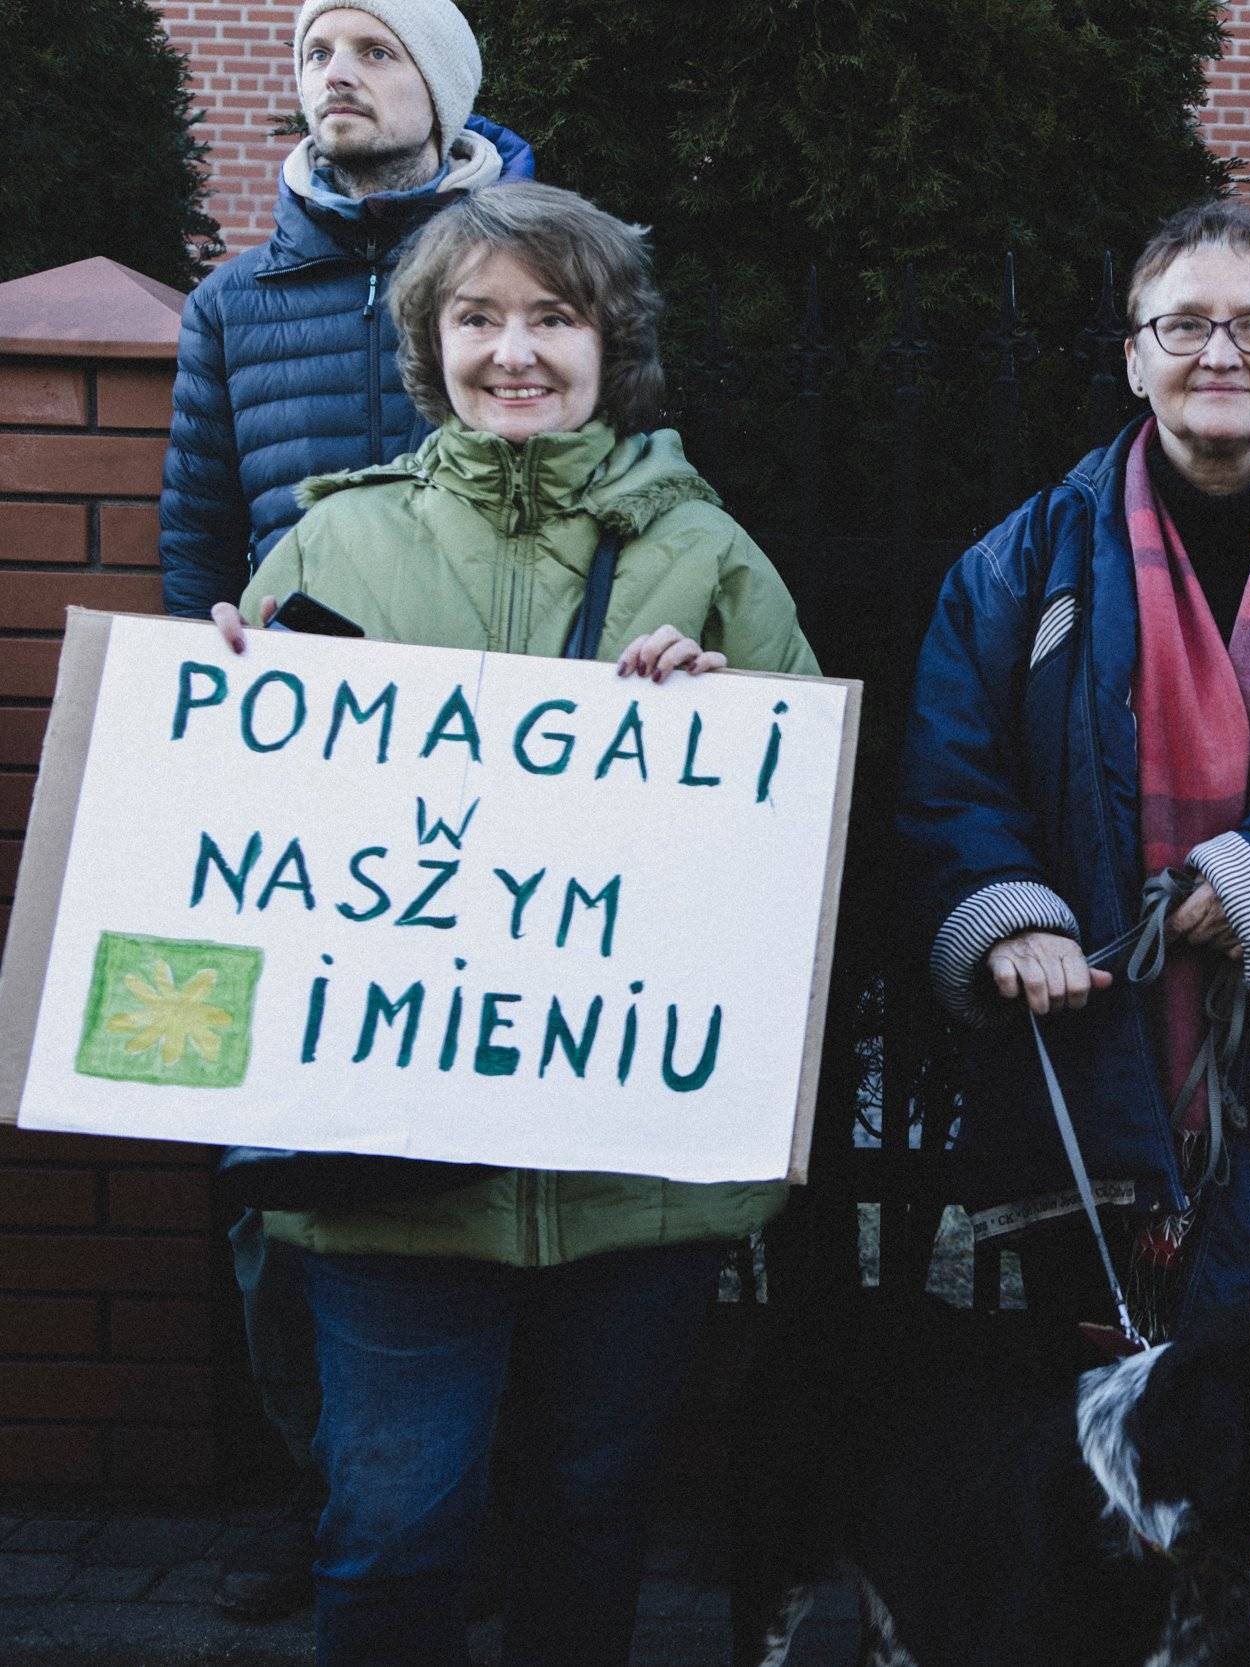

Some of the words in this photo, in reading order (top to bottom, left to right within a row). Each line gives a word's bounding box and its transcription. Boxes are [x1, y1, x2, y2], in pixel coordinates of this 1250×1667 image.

[172, 661, 788, 803] POMAGALI
[417, 797, 478, 849] W
[191, 832, 621, 957] NASZYM
